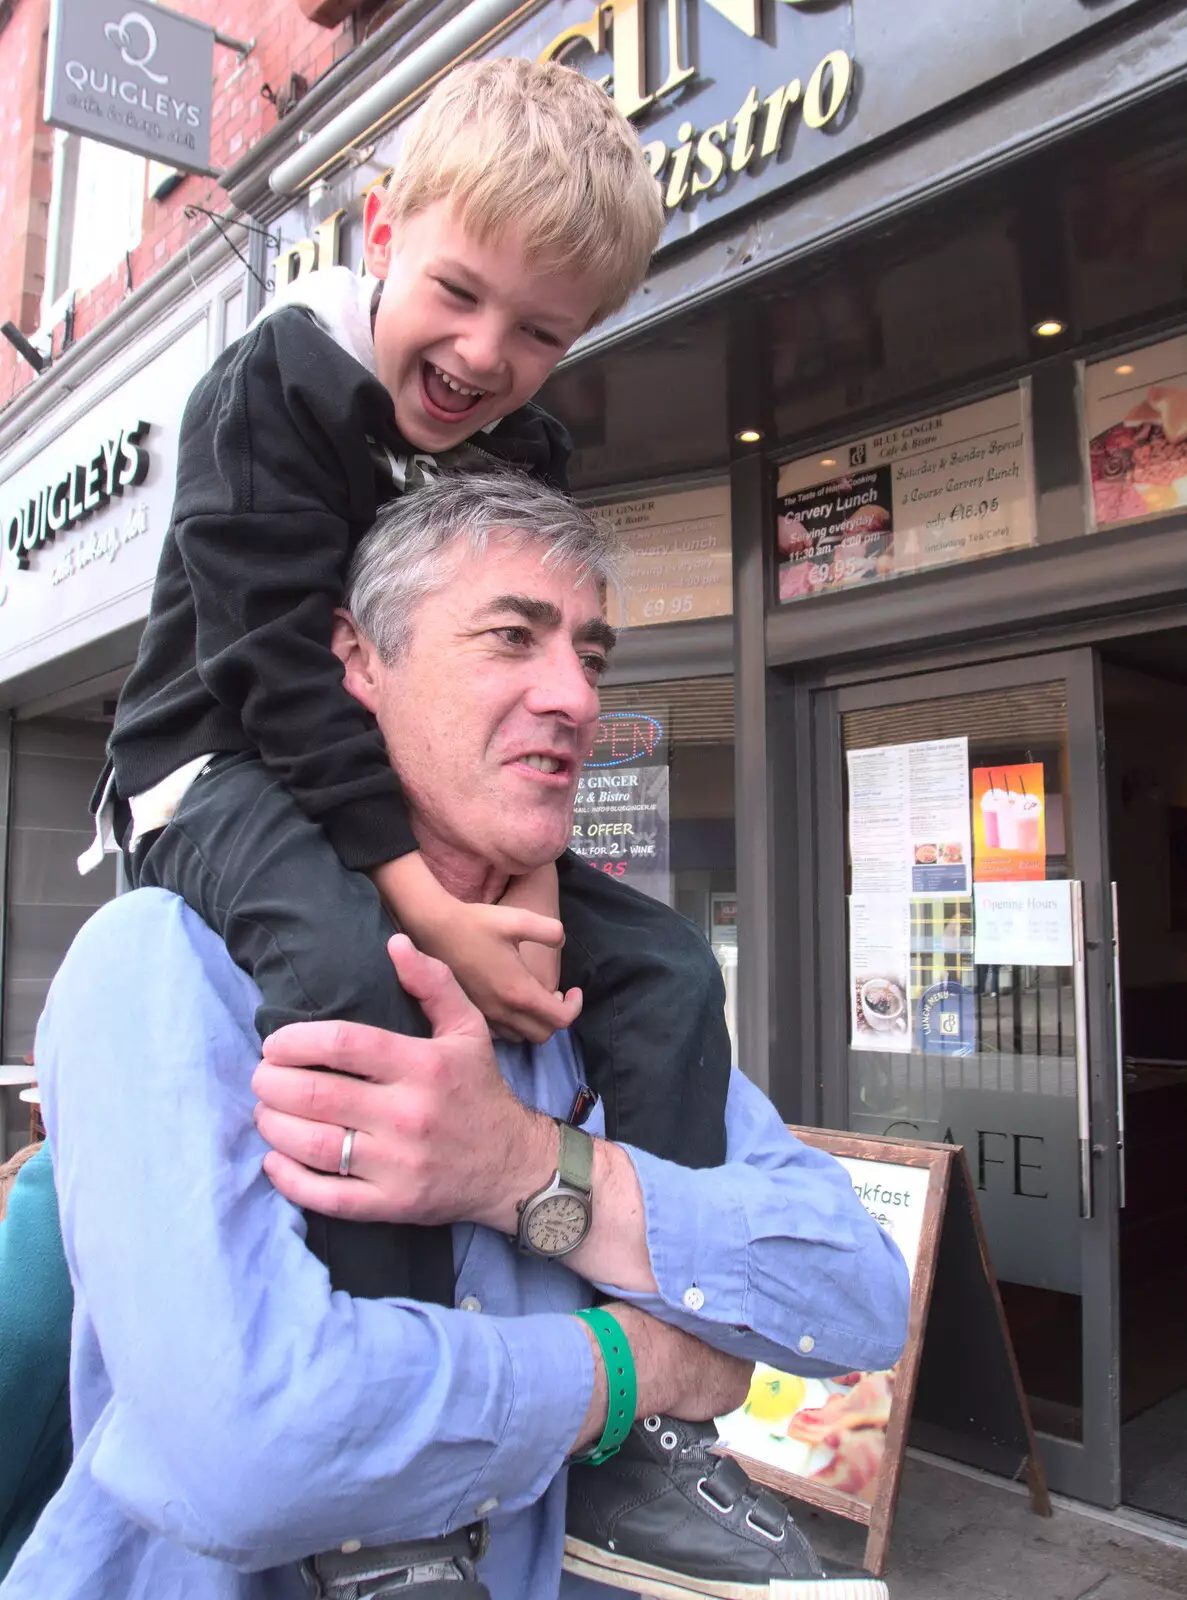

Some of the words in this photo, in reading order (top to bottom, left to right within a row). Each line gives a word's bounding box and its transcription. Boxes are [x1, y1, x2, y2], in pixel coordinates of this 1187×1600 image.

[65, 60, 200, 127] QUIGLEYS
[873, 434, 897, 448] BLUE
[901, 418, 943, 439] GINGER
[895, 460, 937, 481] Saturday
[949, 448, 986, 466] Sunday
[987, 432, 1024, 456] Special
[901, 443, 908, 453] &
[7, 419, 151, 570] QUIGLEYS
[784, 497, 796, 506] The
[798, 491, 816, 503] Taste
[817, 487, 825, 496] of
[850, 472, 877, 486] Cooking
[910, 487, 943, 502] Course
[945, 475, 984, 493] Carvery
[986, 461, 1020, 482] Lunch
[615, 501, 655, 515] GINGER
[784, 502, 833, 525] Carvery
[836, 488, 878, 512] Lunch
[790, 526, 828, 544] Serving
[828, 514, 875, 535] everyday
[925, 512, 949, 530] only
[674, 535, 717, 554] Lunch
[788, 547, 814, 562] 11:30
[816, 543, 831, 556] am
[863, 531, 881, 545] pm
[808, 558, 856, 584] €9.95
[643, 594, 694, 618] €9.95
[589, 722, 654, 758] PEN
[587, 775, 639, 788] GINGER
[586, 794, 596, 803] &
[598, 790, 630, 802] Bistro
[587, 822, 635, 837] OFFER
[589, 846, 608, 855] FOR
[609, 842, 620, 854] 2
[630, 845, 654, 854] WINE
[982, 898, 1025, 912] Opening
[1027, 897, 1058, 910] Hours
[920, 1004, 933, 1036] LUNCH
[927, 991, 950, 1008] MENU
[883, 1121, 1049, 1199] FE
[853, 1182, 911, 1207] akfast
